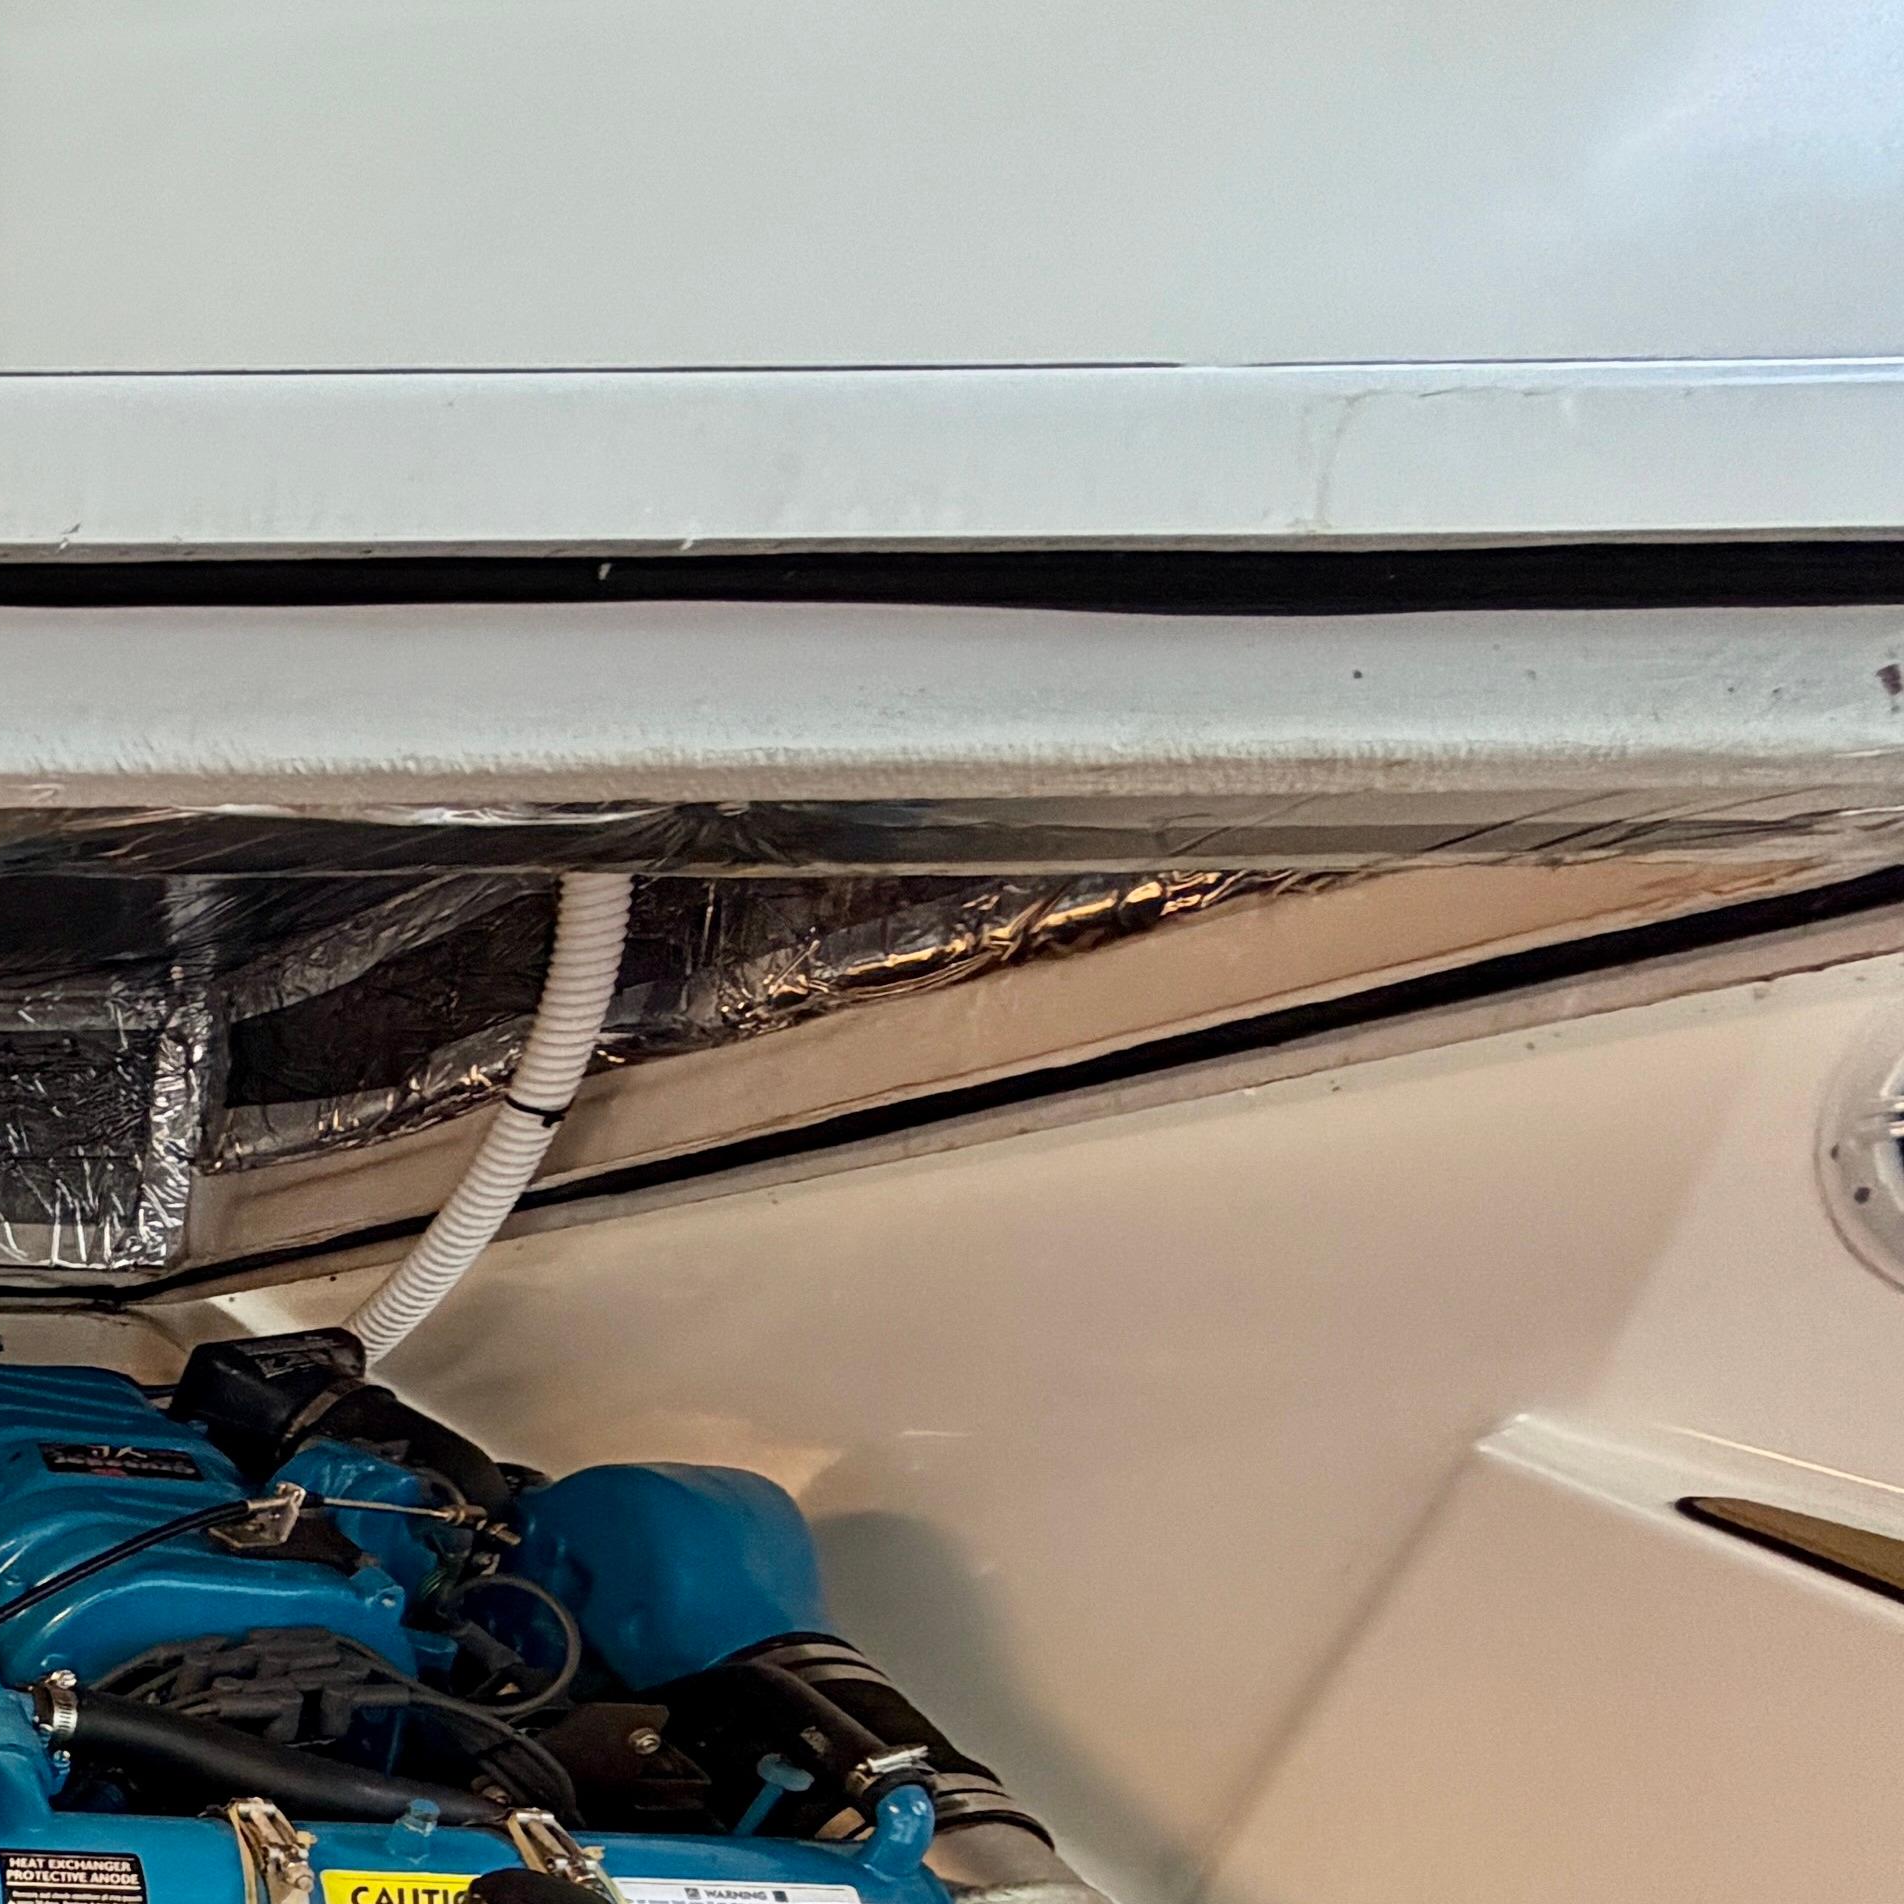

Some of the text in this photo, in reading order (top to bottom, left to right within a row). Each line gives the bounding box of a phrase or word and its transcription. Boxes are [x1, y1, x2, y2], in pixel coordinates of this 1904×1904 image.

[9, 1857, 132, 1872] HEAT EXCHANGER
[5, 1869, 140, 1885] PROTECTIVE ANODE
[703, 1889, 768, 1900] WARNING
